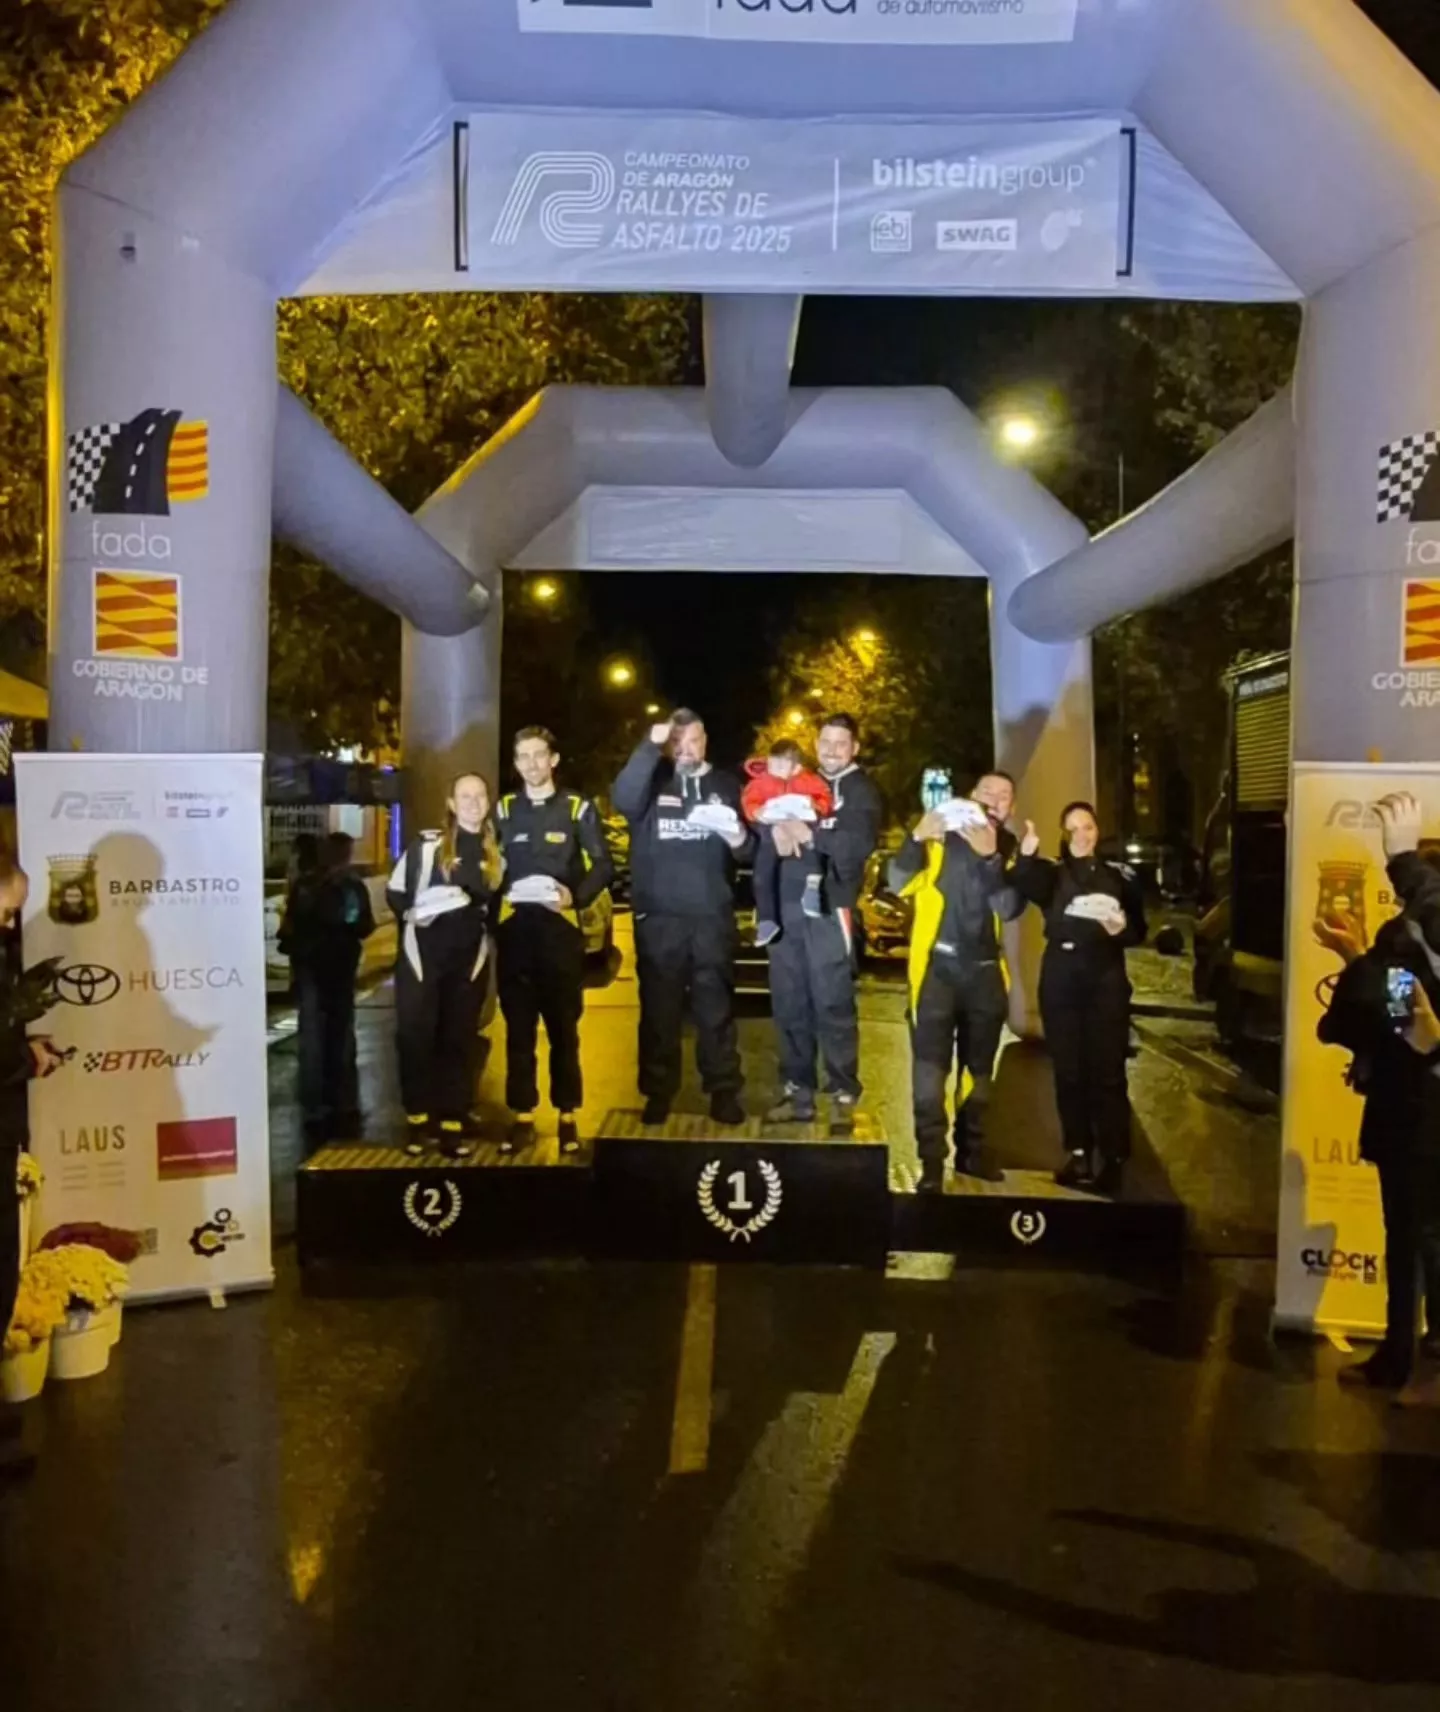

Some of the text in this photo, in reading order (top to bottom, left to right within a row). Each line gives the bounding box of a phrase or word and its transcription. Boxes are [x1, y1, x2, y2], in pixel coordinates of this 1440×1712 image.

[624, 152, 751, 170] CAMPEONATO
[623, 171, 649, 186] DE
[616, 189, 768, 218] RALLYES DE
[612, 223, 793, 252] ASFALTO 2025
[943, 226, 1011, 243] SWAG
[92, 521, 171, 558] fada
[1406, 528, 1440, 564] fa
[182, 667, 208, 685] DE
[1372, 672, 1440, 690] GOBIE
[109, 878, 240, 895] BARBASTRO
[129, 967, 243, 992] HUESCA
[60, 1124, 126, 1154] LAUS
[1312, 1137, 1361, 1166] LAU
[423, 1188, 442, 1215] 2
[727, 1171, 753, 1210] 1
[1022, 1214, 1034, 1232] 3
[1301, 1248, 1378, 1272] CLOCK
